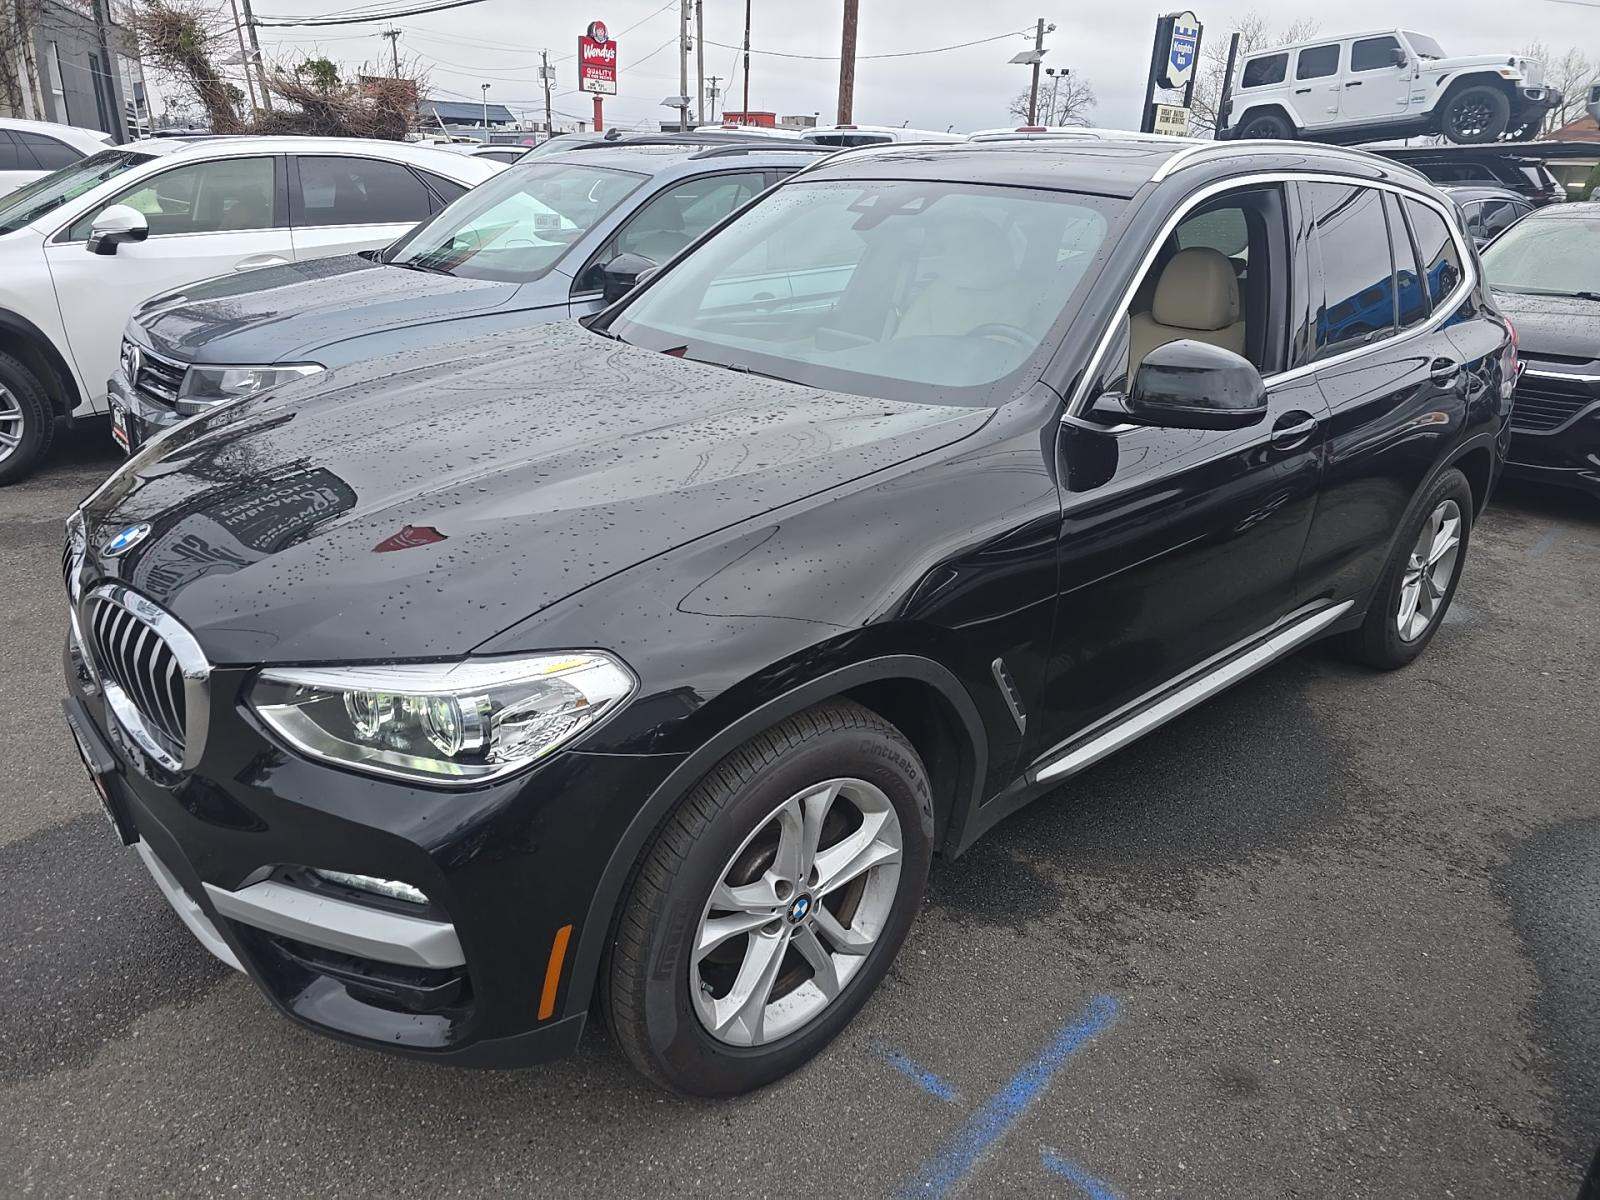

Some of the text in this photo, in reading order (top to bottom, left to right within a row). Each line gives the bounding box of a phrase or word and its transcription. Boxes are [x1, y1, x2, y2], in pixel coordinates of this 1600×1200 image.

[584, 43, 616, 62] Wendy's
[1174, 41, 1192, 53] Knights
[1177, 53, 1186, 65] Inn
[586, 67, 612, 76] QUALITY
